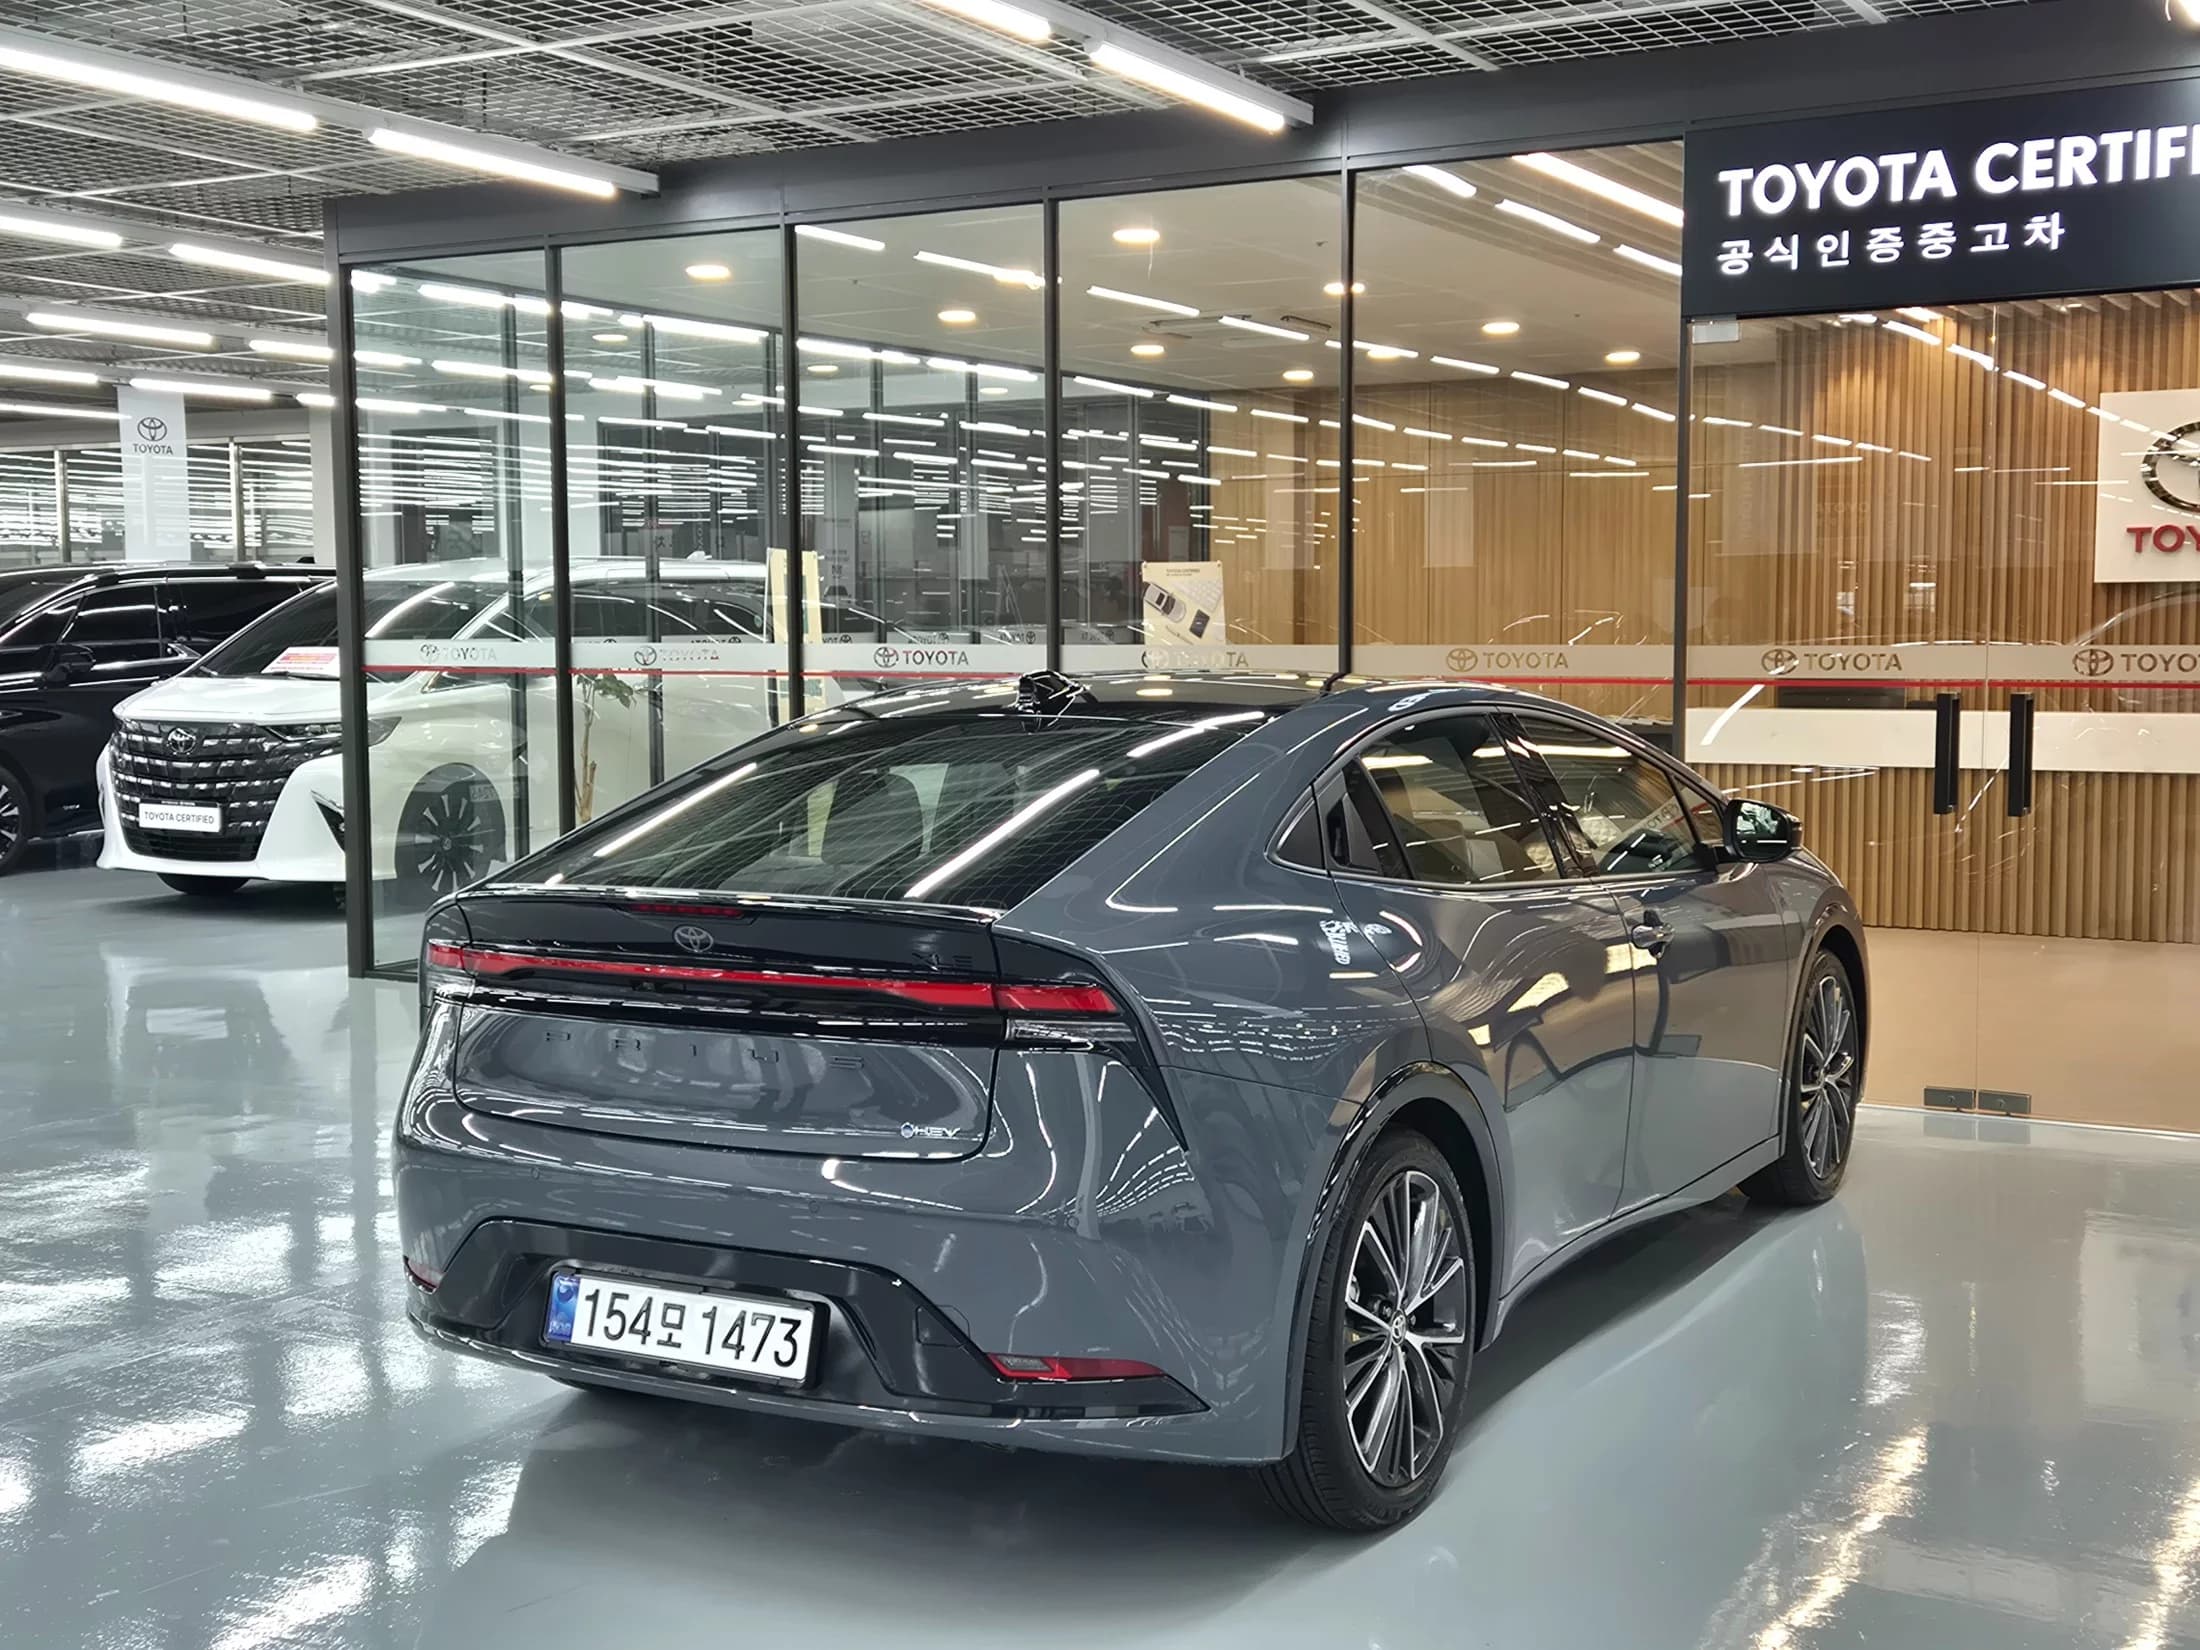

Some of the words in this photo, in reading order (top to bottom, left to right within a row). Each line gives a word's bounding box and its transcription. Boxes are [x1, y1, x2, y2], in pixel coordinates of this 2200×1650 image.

[1718, 149, 1958, 217] TOYOTA
[133, 443, 174, 456] TOYOTA
[903, 650, 969, 666] TOYOTA
[1482, 652, 1569, 669] TOYOTA
[1803, 653, 1902, 671] TOYOTA
[2120, 653, 2200, 672] TOYO
[144, 811, 174, 822] TOYOTA
[702, 1305, 802, 1368] 1473
